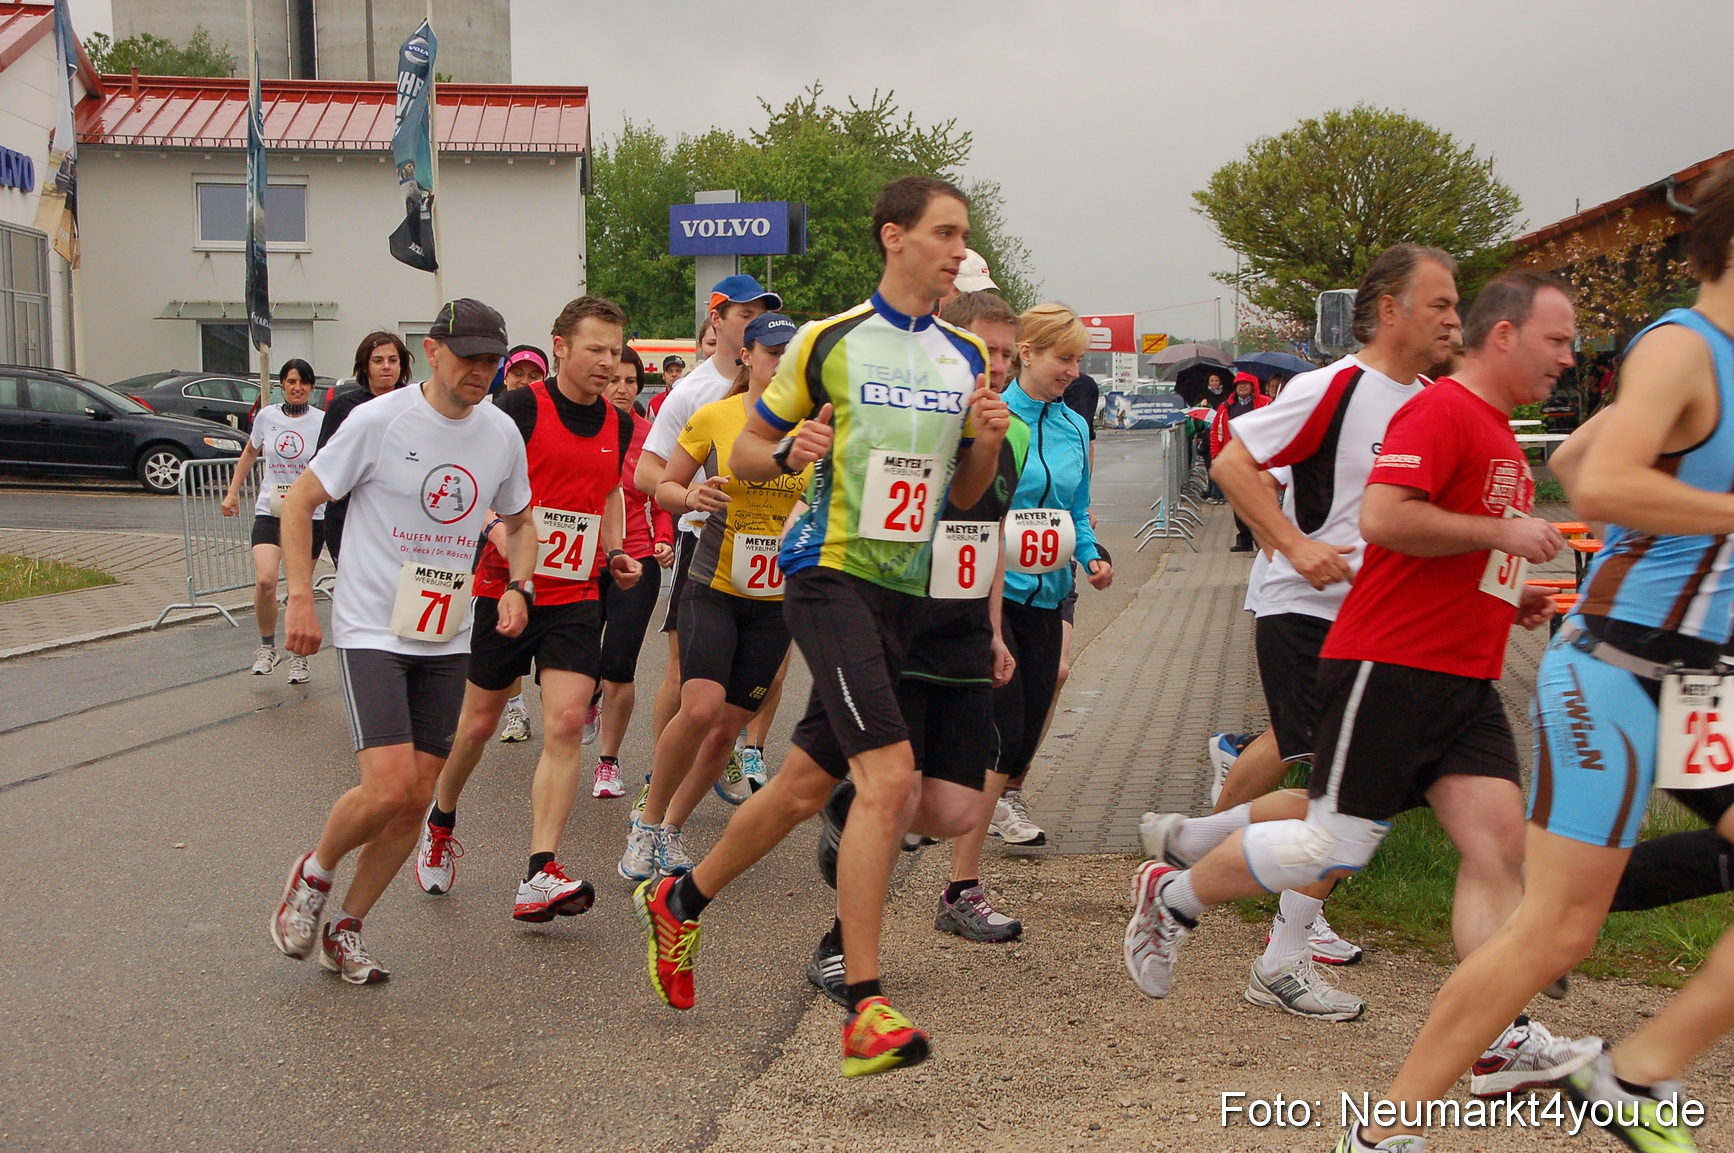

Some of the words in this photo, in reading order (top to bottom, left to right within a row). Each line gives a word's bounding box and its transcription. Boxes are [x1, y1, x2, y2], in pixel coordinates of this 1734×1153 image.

[680, 218, 770, 237] VOLVO
[863, 363, 929, 387] TEAM
[860, 382, 963, 414] BOCK
[884, 456, 922, 469] MEYER
[746, 490, 794, 499] APOTHEKE
[884, 480, 927, 533] 23
[543, 511, 577, 524] MEYER
[1015, 512, 1047, 521] MEYER
[1016, 519, 1049, 527] WERBUNG
[543, 520, 576, 530] WERBUNG
[946, 525, 979, 534] MEYER
[393, 527, 431, 542] LAUFEN
[435, 535, 453, 544] MIT
[745, 537, 777, 546] MEYER
[946, 533, 979, 541] WERBUNG
[543, 531, 584, 572] 24
[1020, 529, 1059, 568] 69
[415, 566, 453, 580] MEYER
[747, 554, 783, 589] 20
[958, 544, 976, 589] 8
[415, 576, 452, 588] WERBUNG
[416, 590, 452, 635] 71
[1684, 711, 1733, 774] 25
